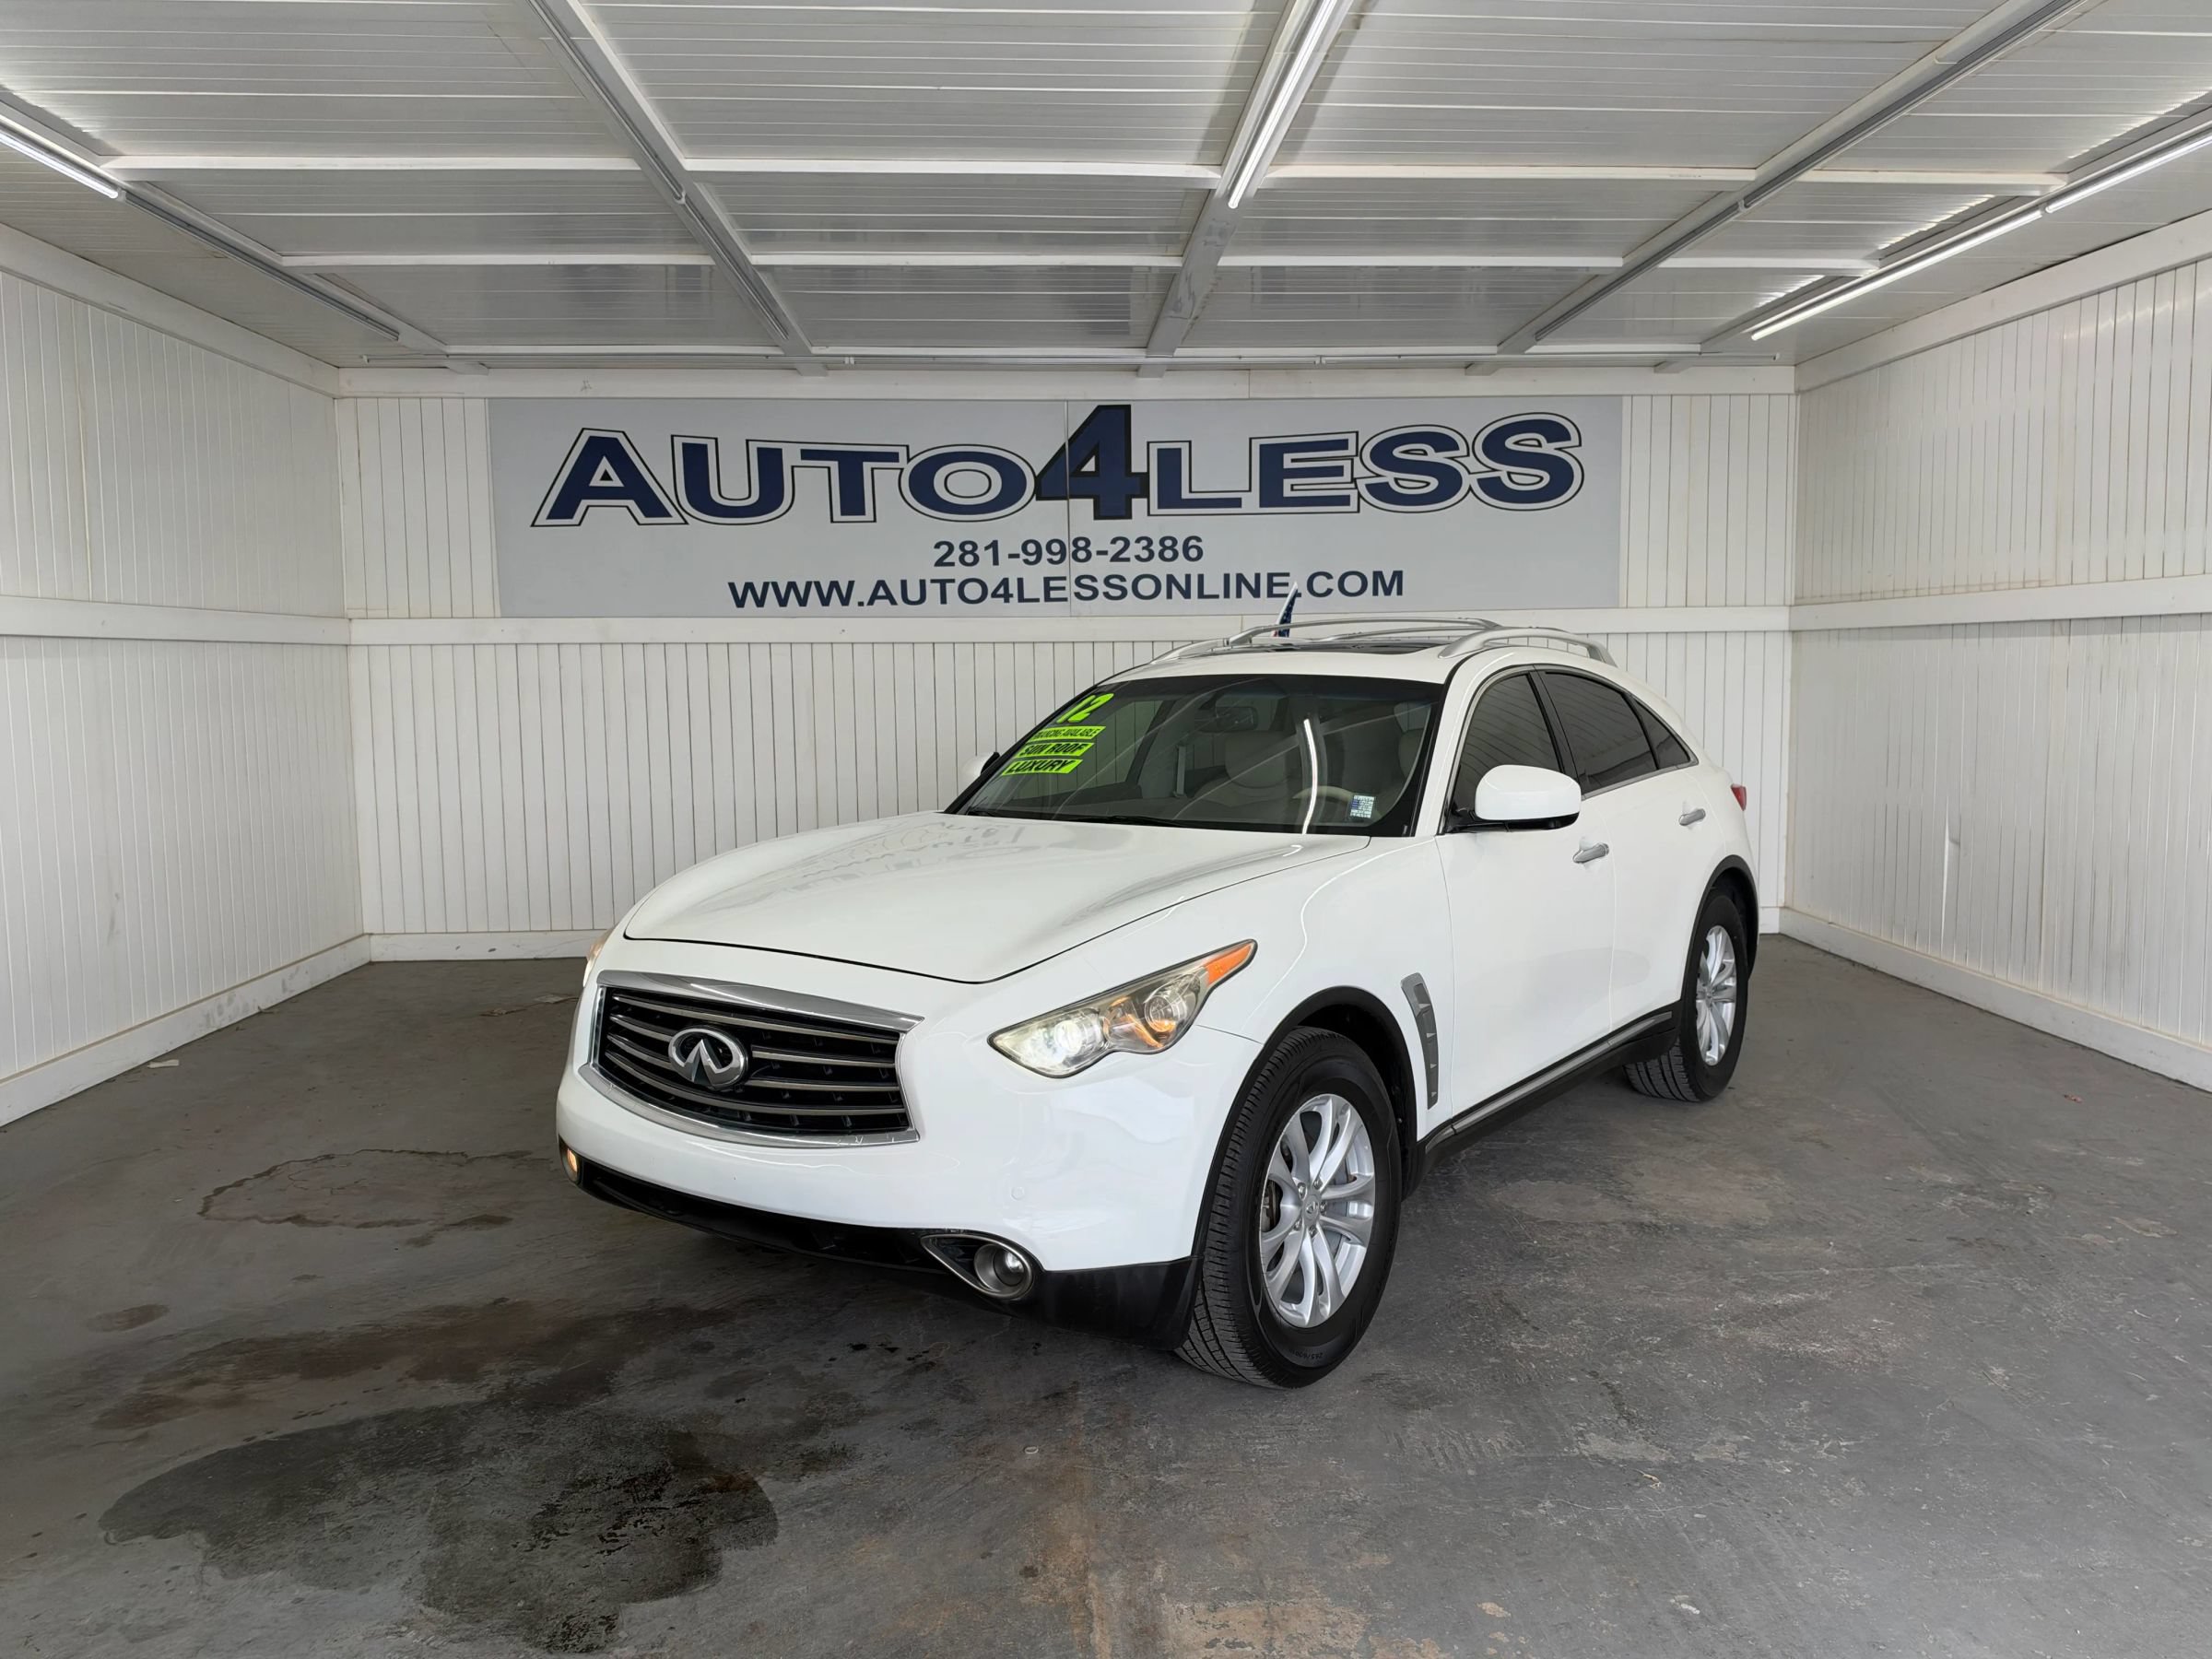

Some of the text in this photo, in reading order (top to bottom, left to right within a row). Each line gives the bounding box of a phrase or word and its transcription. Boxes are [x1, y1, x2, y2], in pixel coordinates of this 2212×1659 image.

[933, 535, 1205, 568] 281-998-2386
[727, 570, 1404, 608] WWW.AUTO4LESSONLINE.COM
[1046, 743, 1090, 754] ROOF
[1008, 759, 1077, 773] LUXURY
